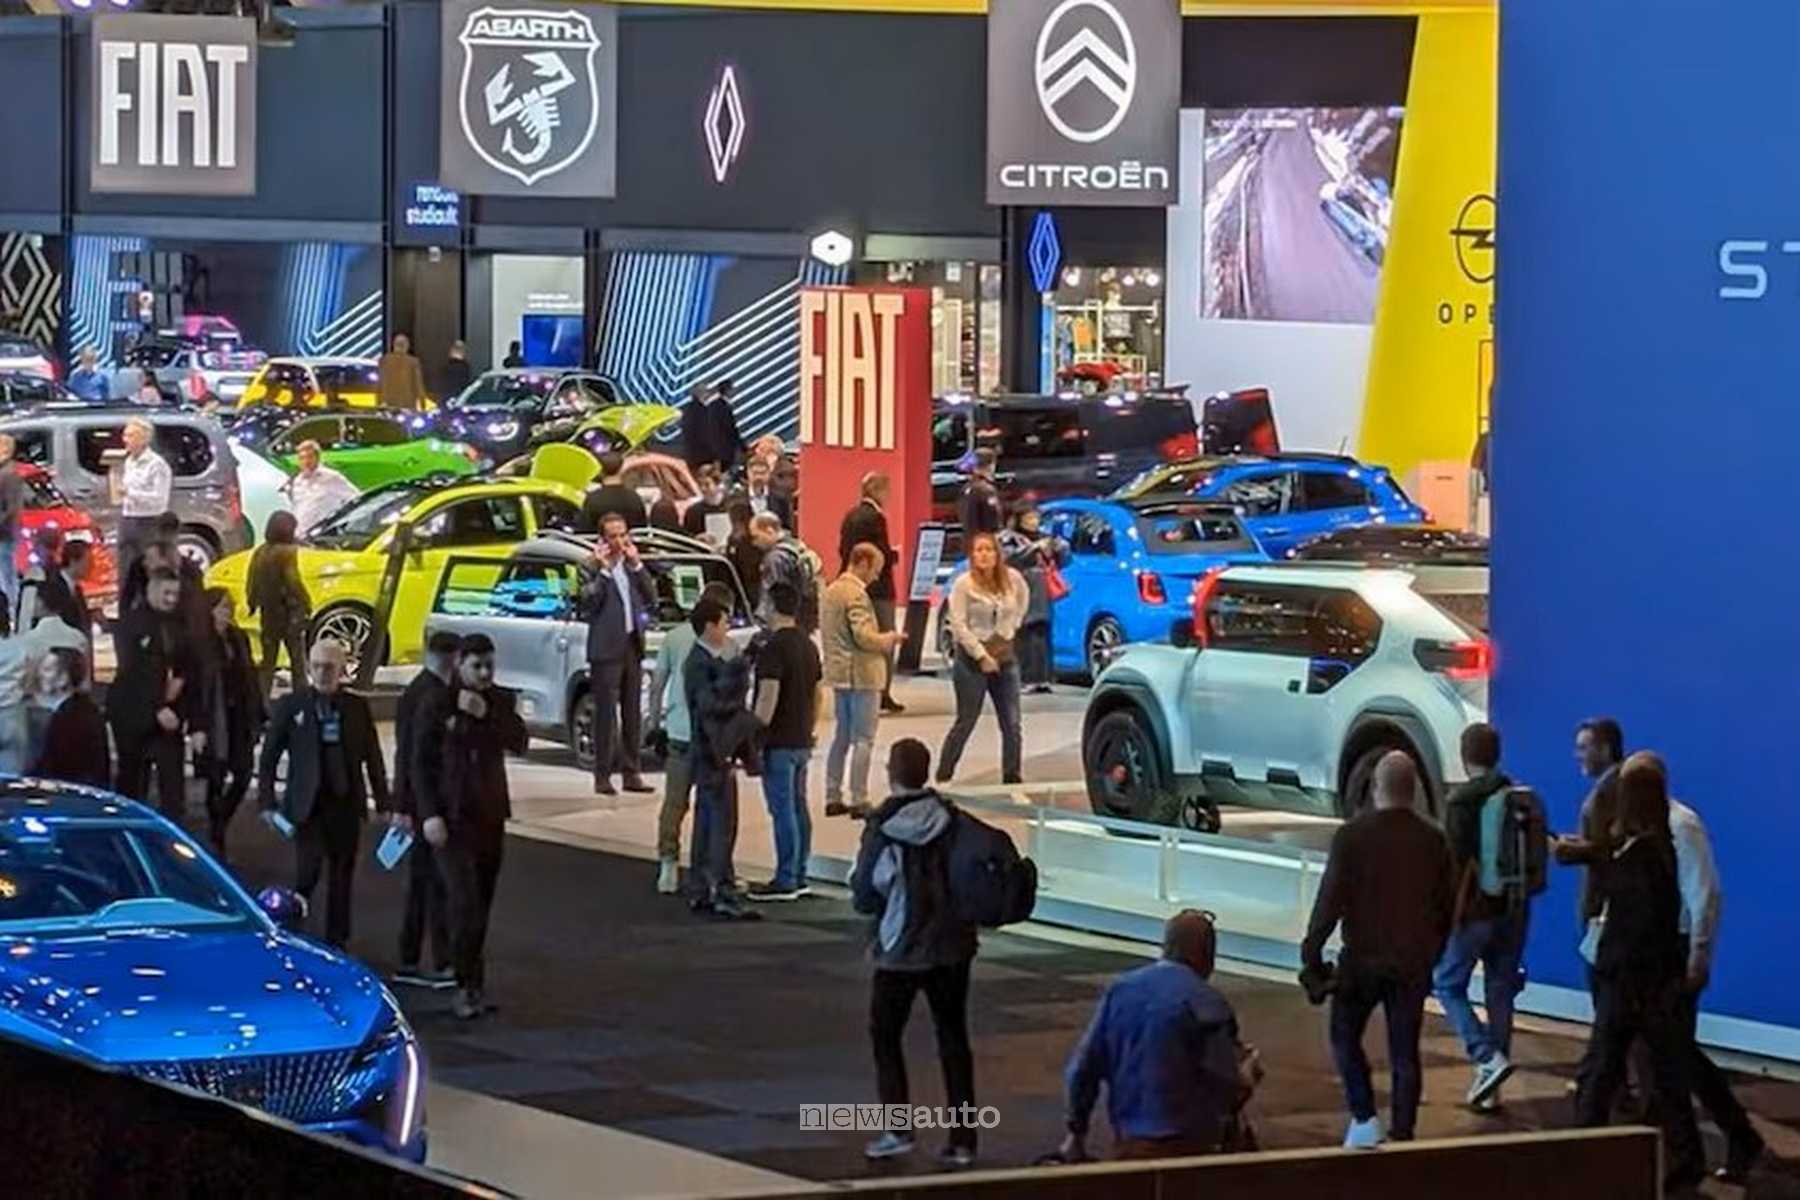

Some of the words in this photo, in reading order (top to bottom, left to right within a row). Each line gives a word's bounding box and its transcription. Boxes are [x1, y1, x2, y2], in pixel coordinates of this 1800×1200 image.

[472, 18, 585, 39] ABARTH
[101, 42, 248, 167] FIAT
[801, 290, 904, 450] FIAT
